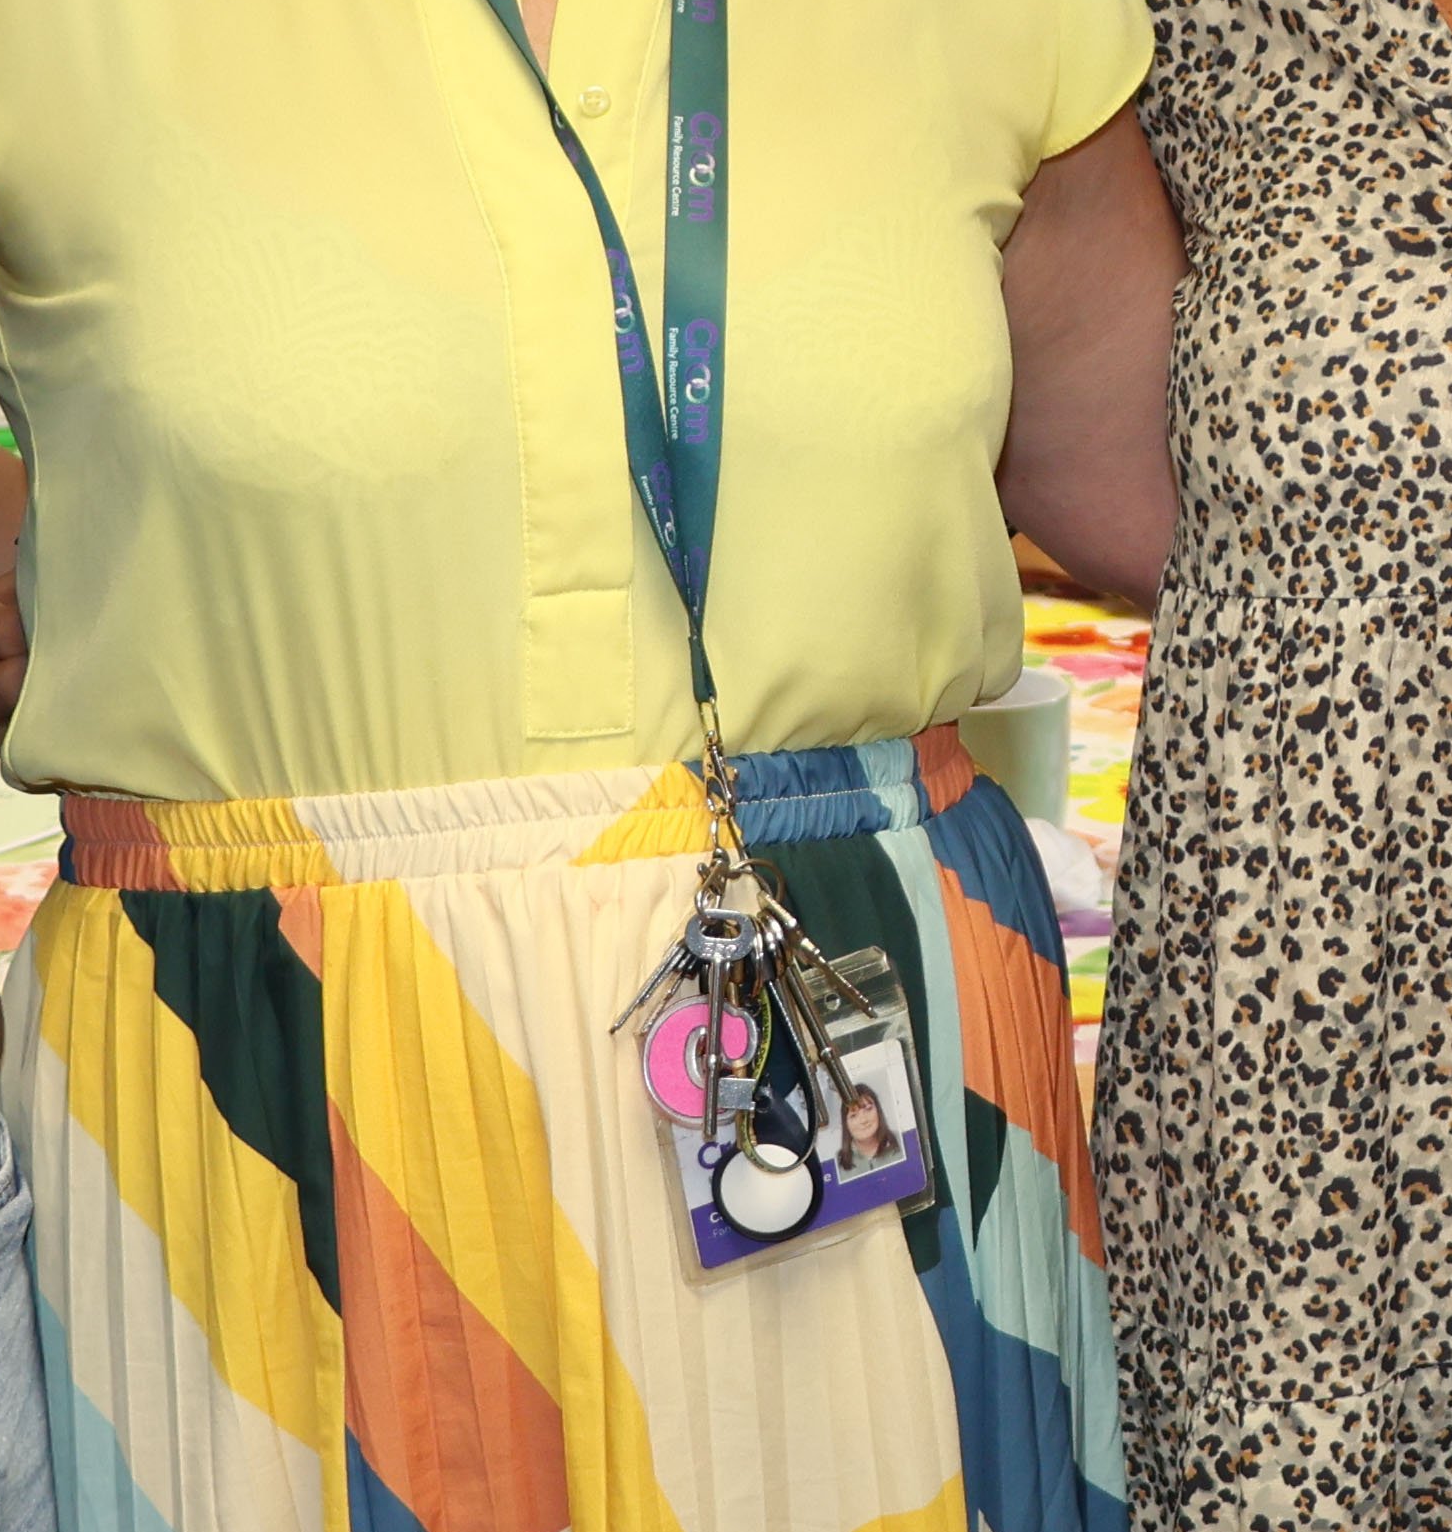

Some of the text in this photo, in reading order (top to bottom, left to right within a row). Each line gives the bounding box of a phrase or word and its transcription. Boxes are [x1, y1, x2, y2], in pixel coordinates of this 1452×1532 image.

[671, 115, 684, 217] Family Resource Centre
[688, 111, 722, 222] Croom
[667, 327, 680, 441] Family Resource Centre
[684, 317, 719, 445] Croom
